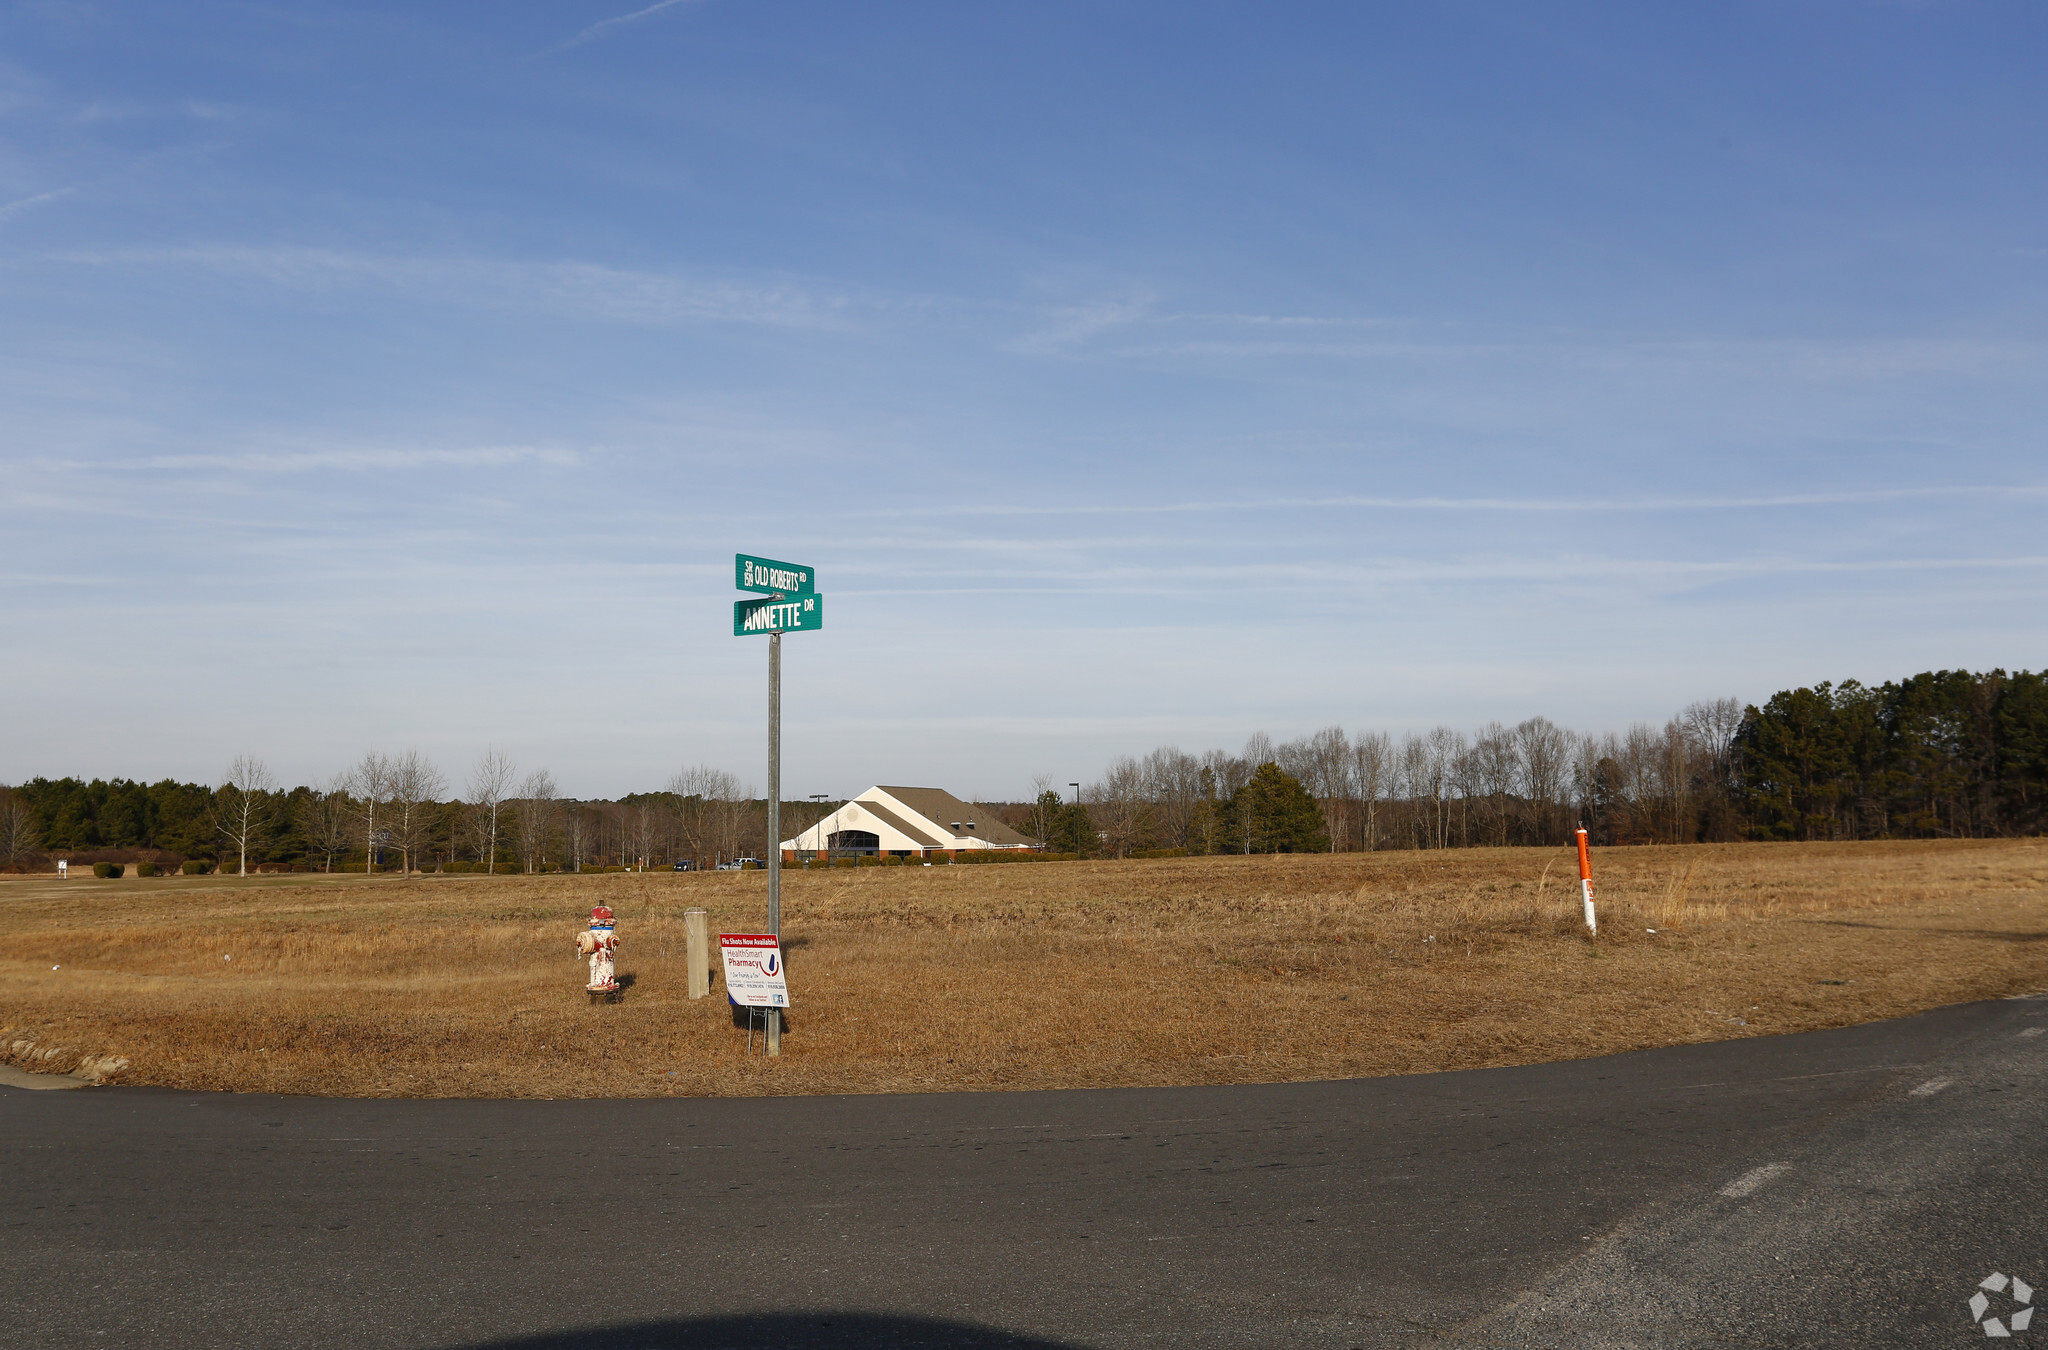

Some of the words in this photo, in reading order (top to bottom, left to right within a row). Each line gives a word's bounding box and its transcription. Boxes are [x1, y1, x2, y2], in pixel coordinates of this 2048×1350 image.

[745, 561, 753, 572] SR
[755, 566, 768, 585] OLD
[770, 569, 798, 591] ROBERTS
[800, 572, 807, 582] RD
[744, 603, 801, 630] ANNETTE
[804, 599, 814, 611] DR
[728, 949, 762, 958] HealthSmart
[729, 958, 758, 969] Pharmacy
